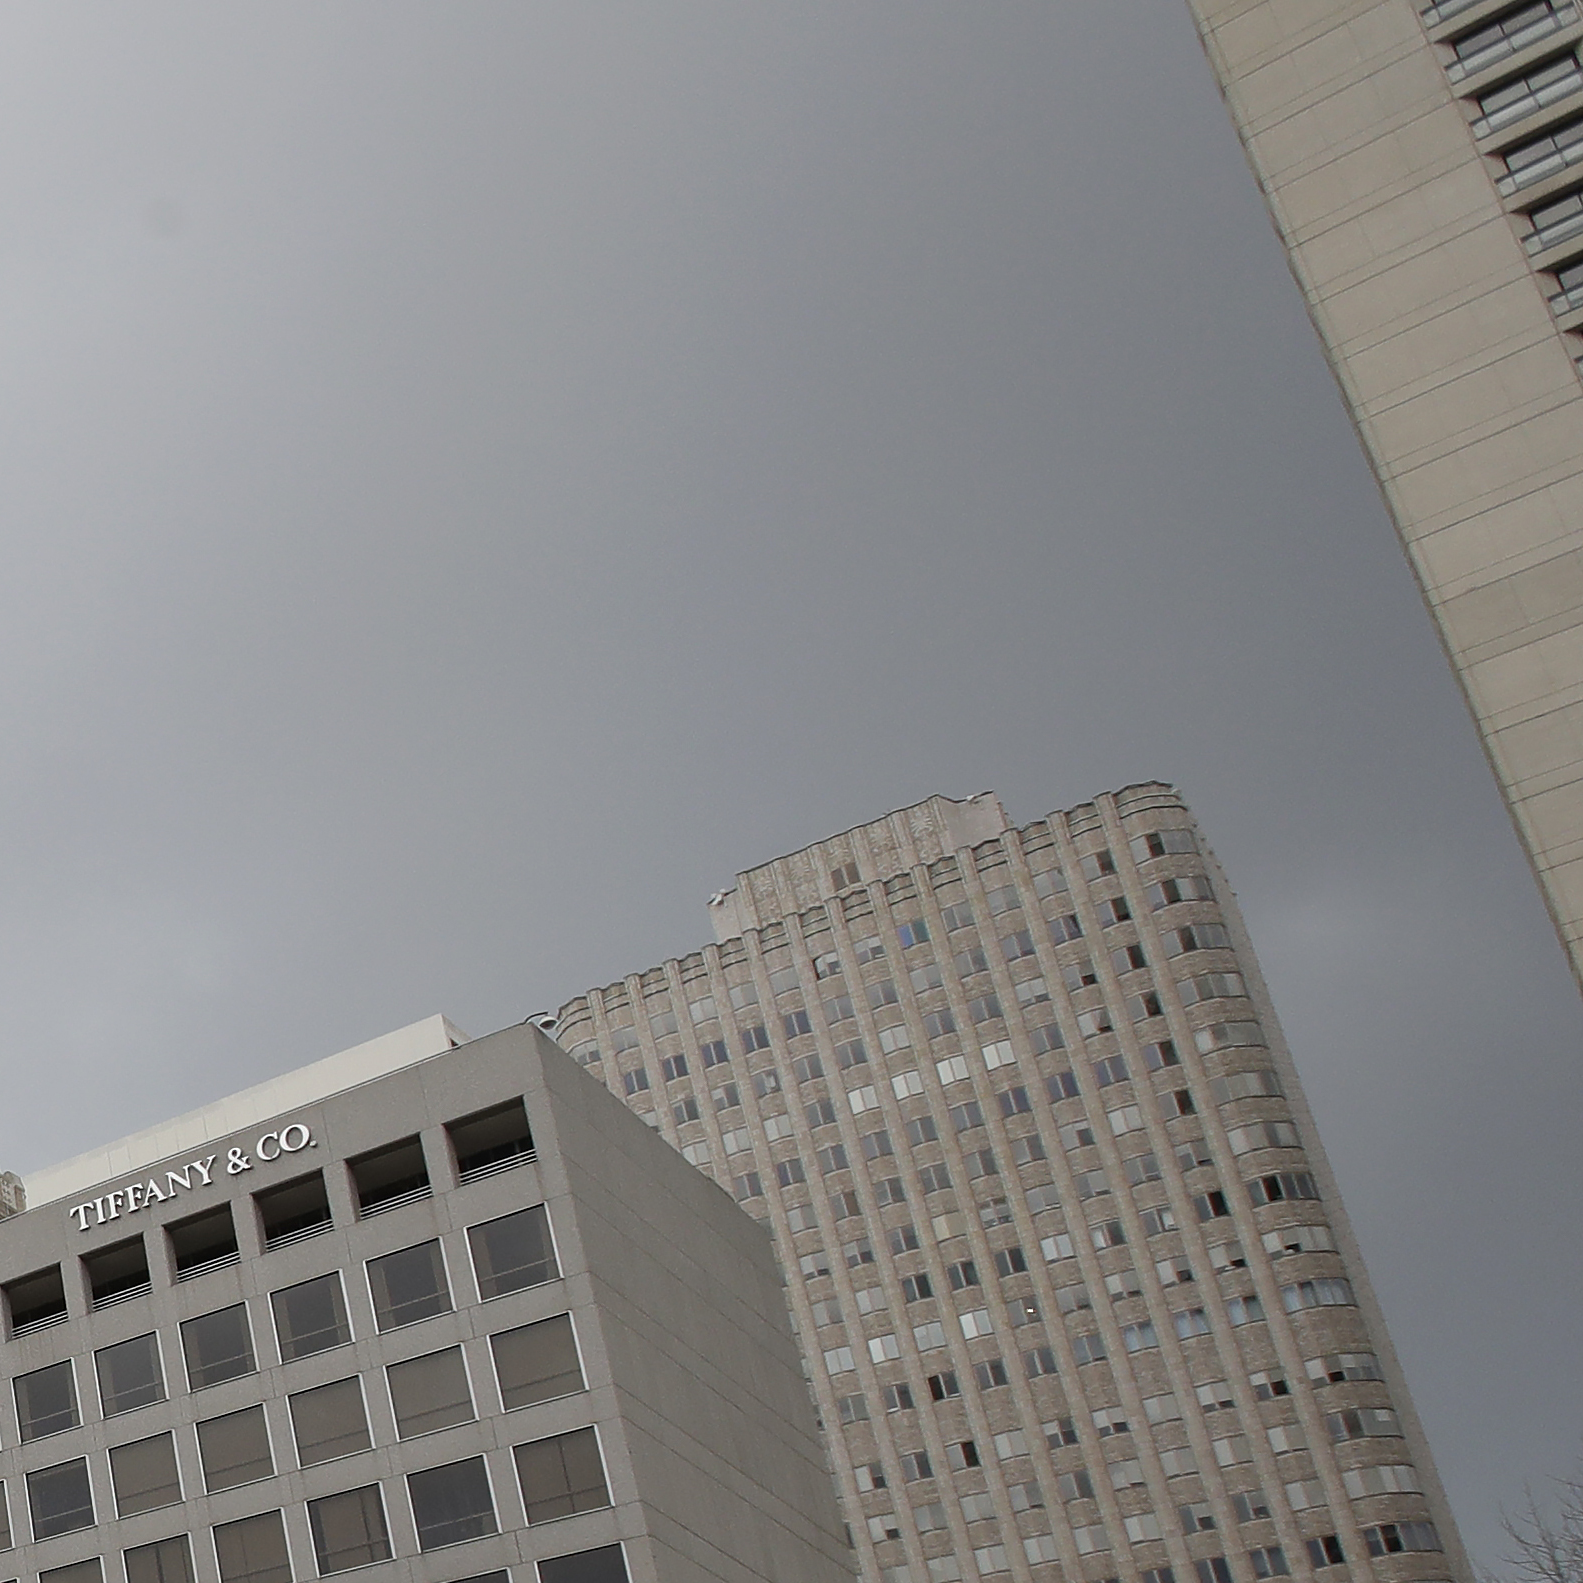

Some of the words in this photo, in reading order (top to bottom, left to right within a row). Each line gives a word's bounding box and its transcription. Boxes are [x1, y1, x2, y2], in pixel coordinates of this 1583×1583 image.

[70, 1155, 216, 1231] TIFFANY
[227, 1147, 253, 1175] &
[256, 1124, 318, 1162] CO.
